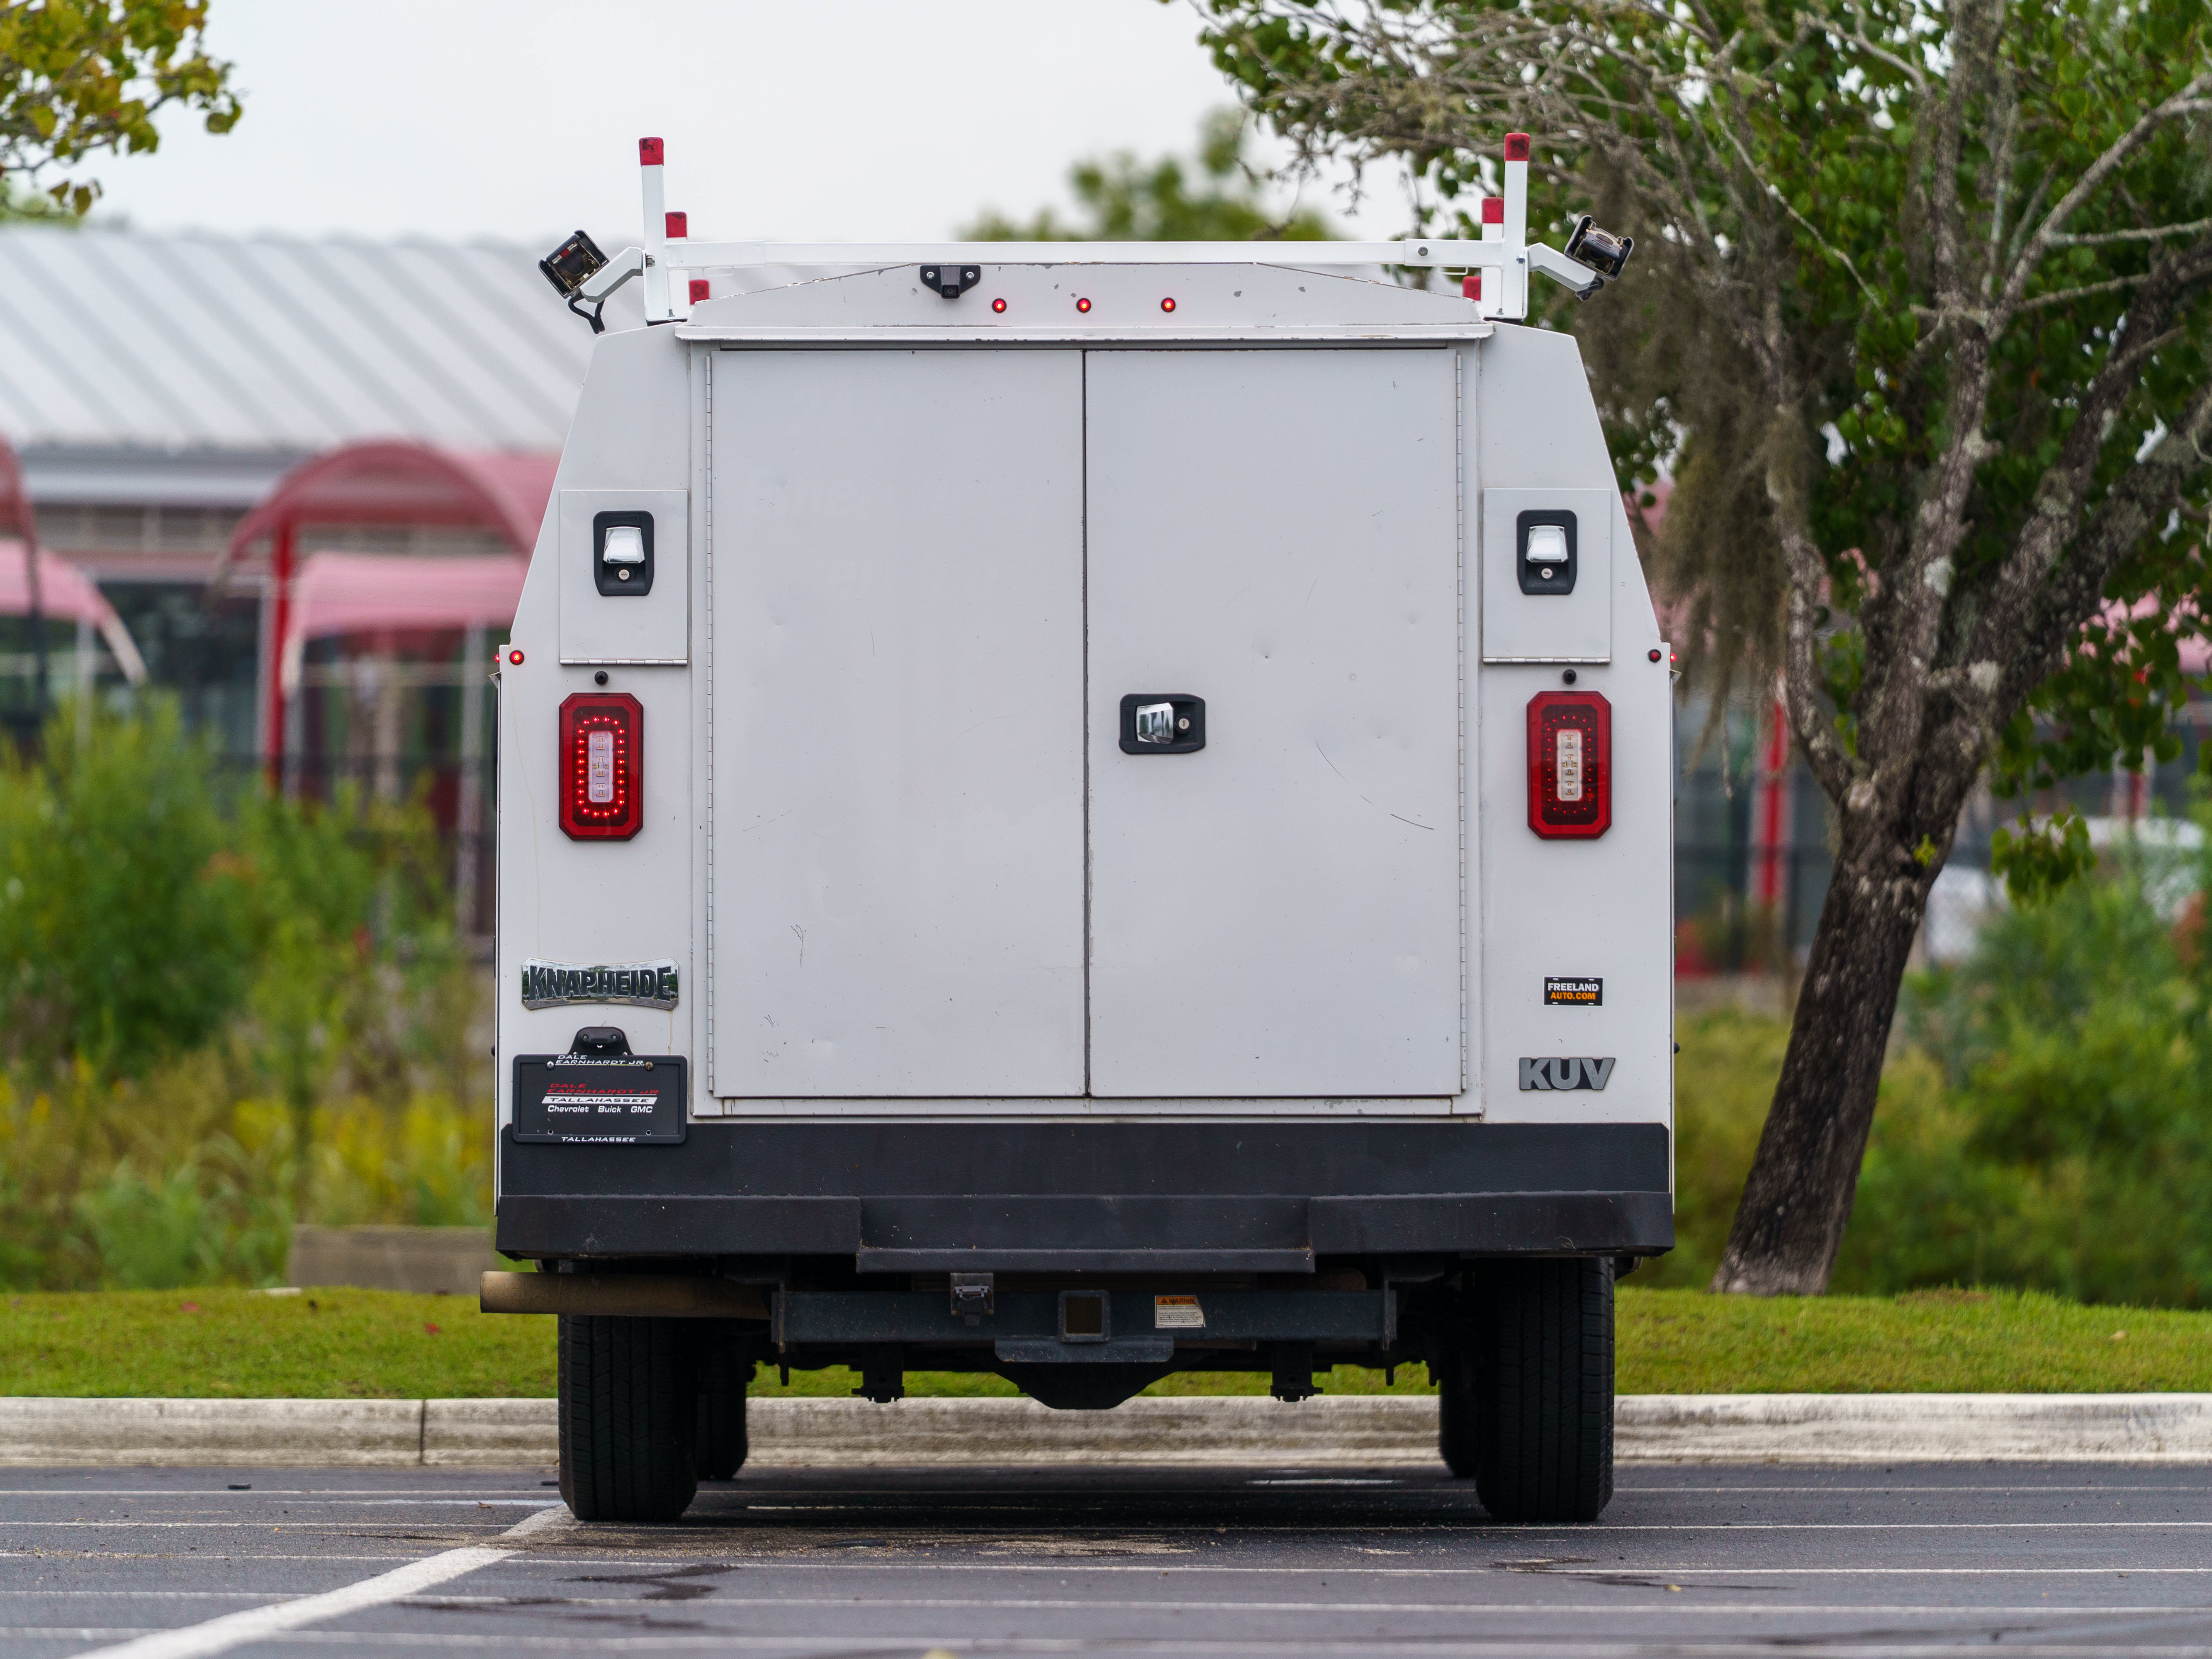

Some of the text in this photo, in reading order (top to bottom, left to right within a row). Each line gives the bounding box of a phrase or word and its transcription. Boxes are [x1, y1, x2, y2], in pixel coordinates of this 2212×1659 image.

[530, 966, 671, 1002] KNAPHEIDE
[1548, 983, 1599, 991] FREELAND
[1550, 992, 1595, 1000] AUTO.COM
[1519, 1057, 1616, 1090] KUV
